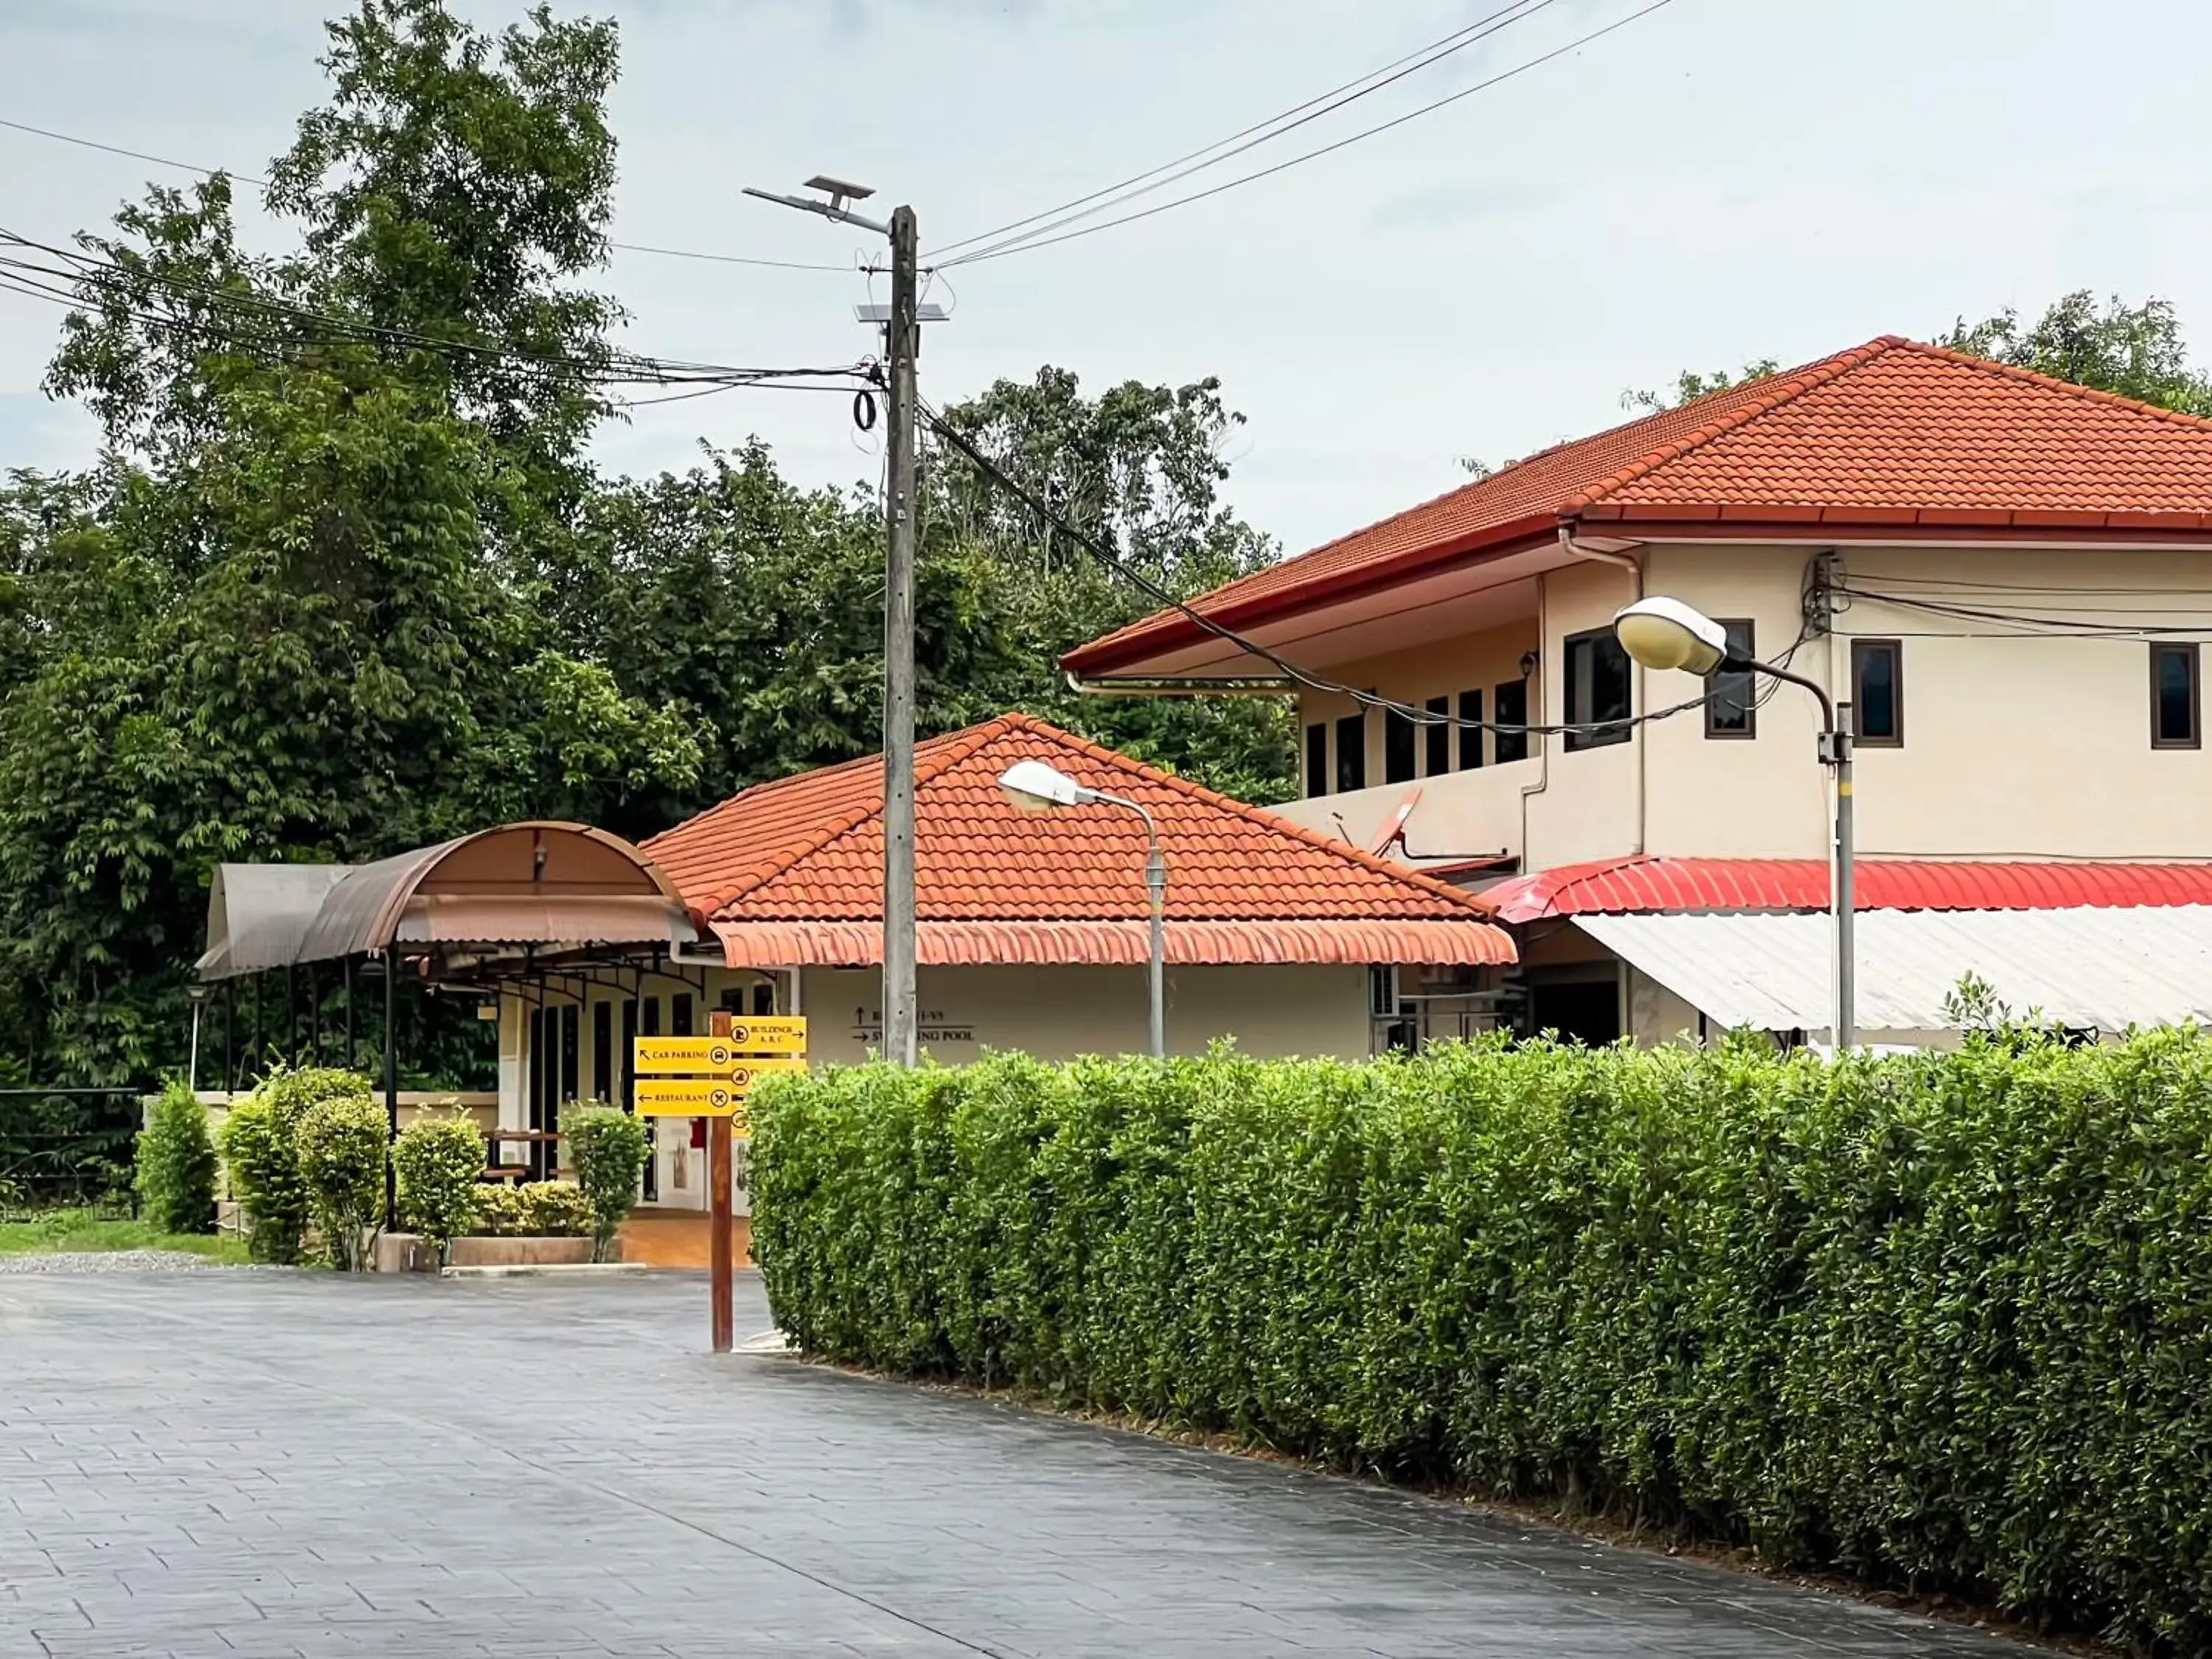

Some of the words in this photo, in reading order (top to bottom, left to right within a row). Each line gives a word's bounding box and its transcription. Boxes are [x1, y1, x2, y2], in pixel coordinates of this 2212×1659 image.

[942, 1031, 975, 1040] POOL
[653, 1051, 669, 1059] CAR
[671, 1051, 709, 1059] PARKING
[655, 1093, 709, 1102] RESTAURANT
